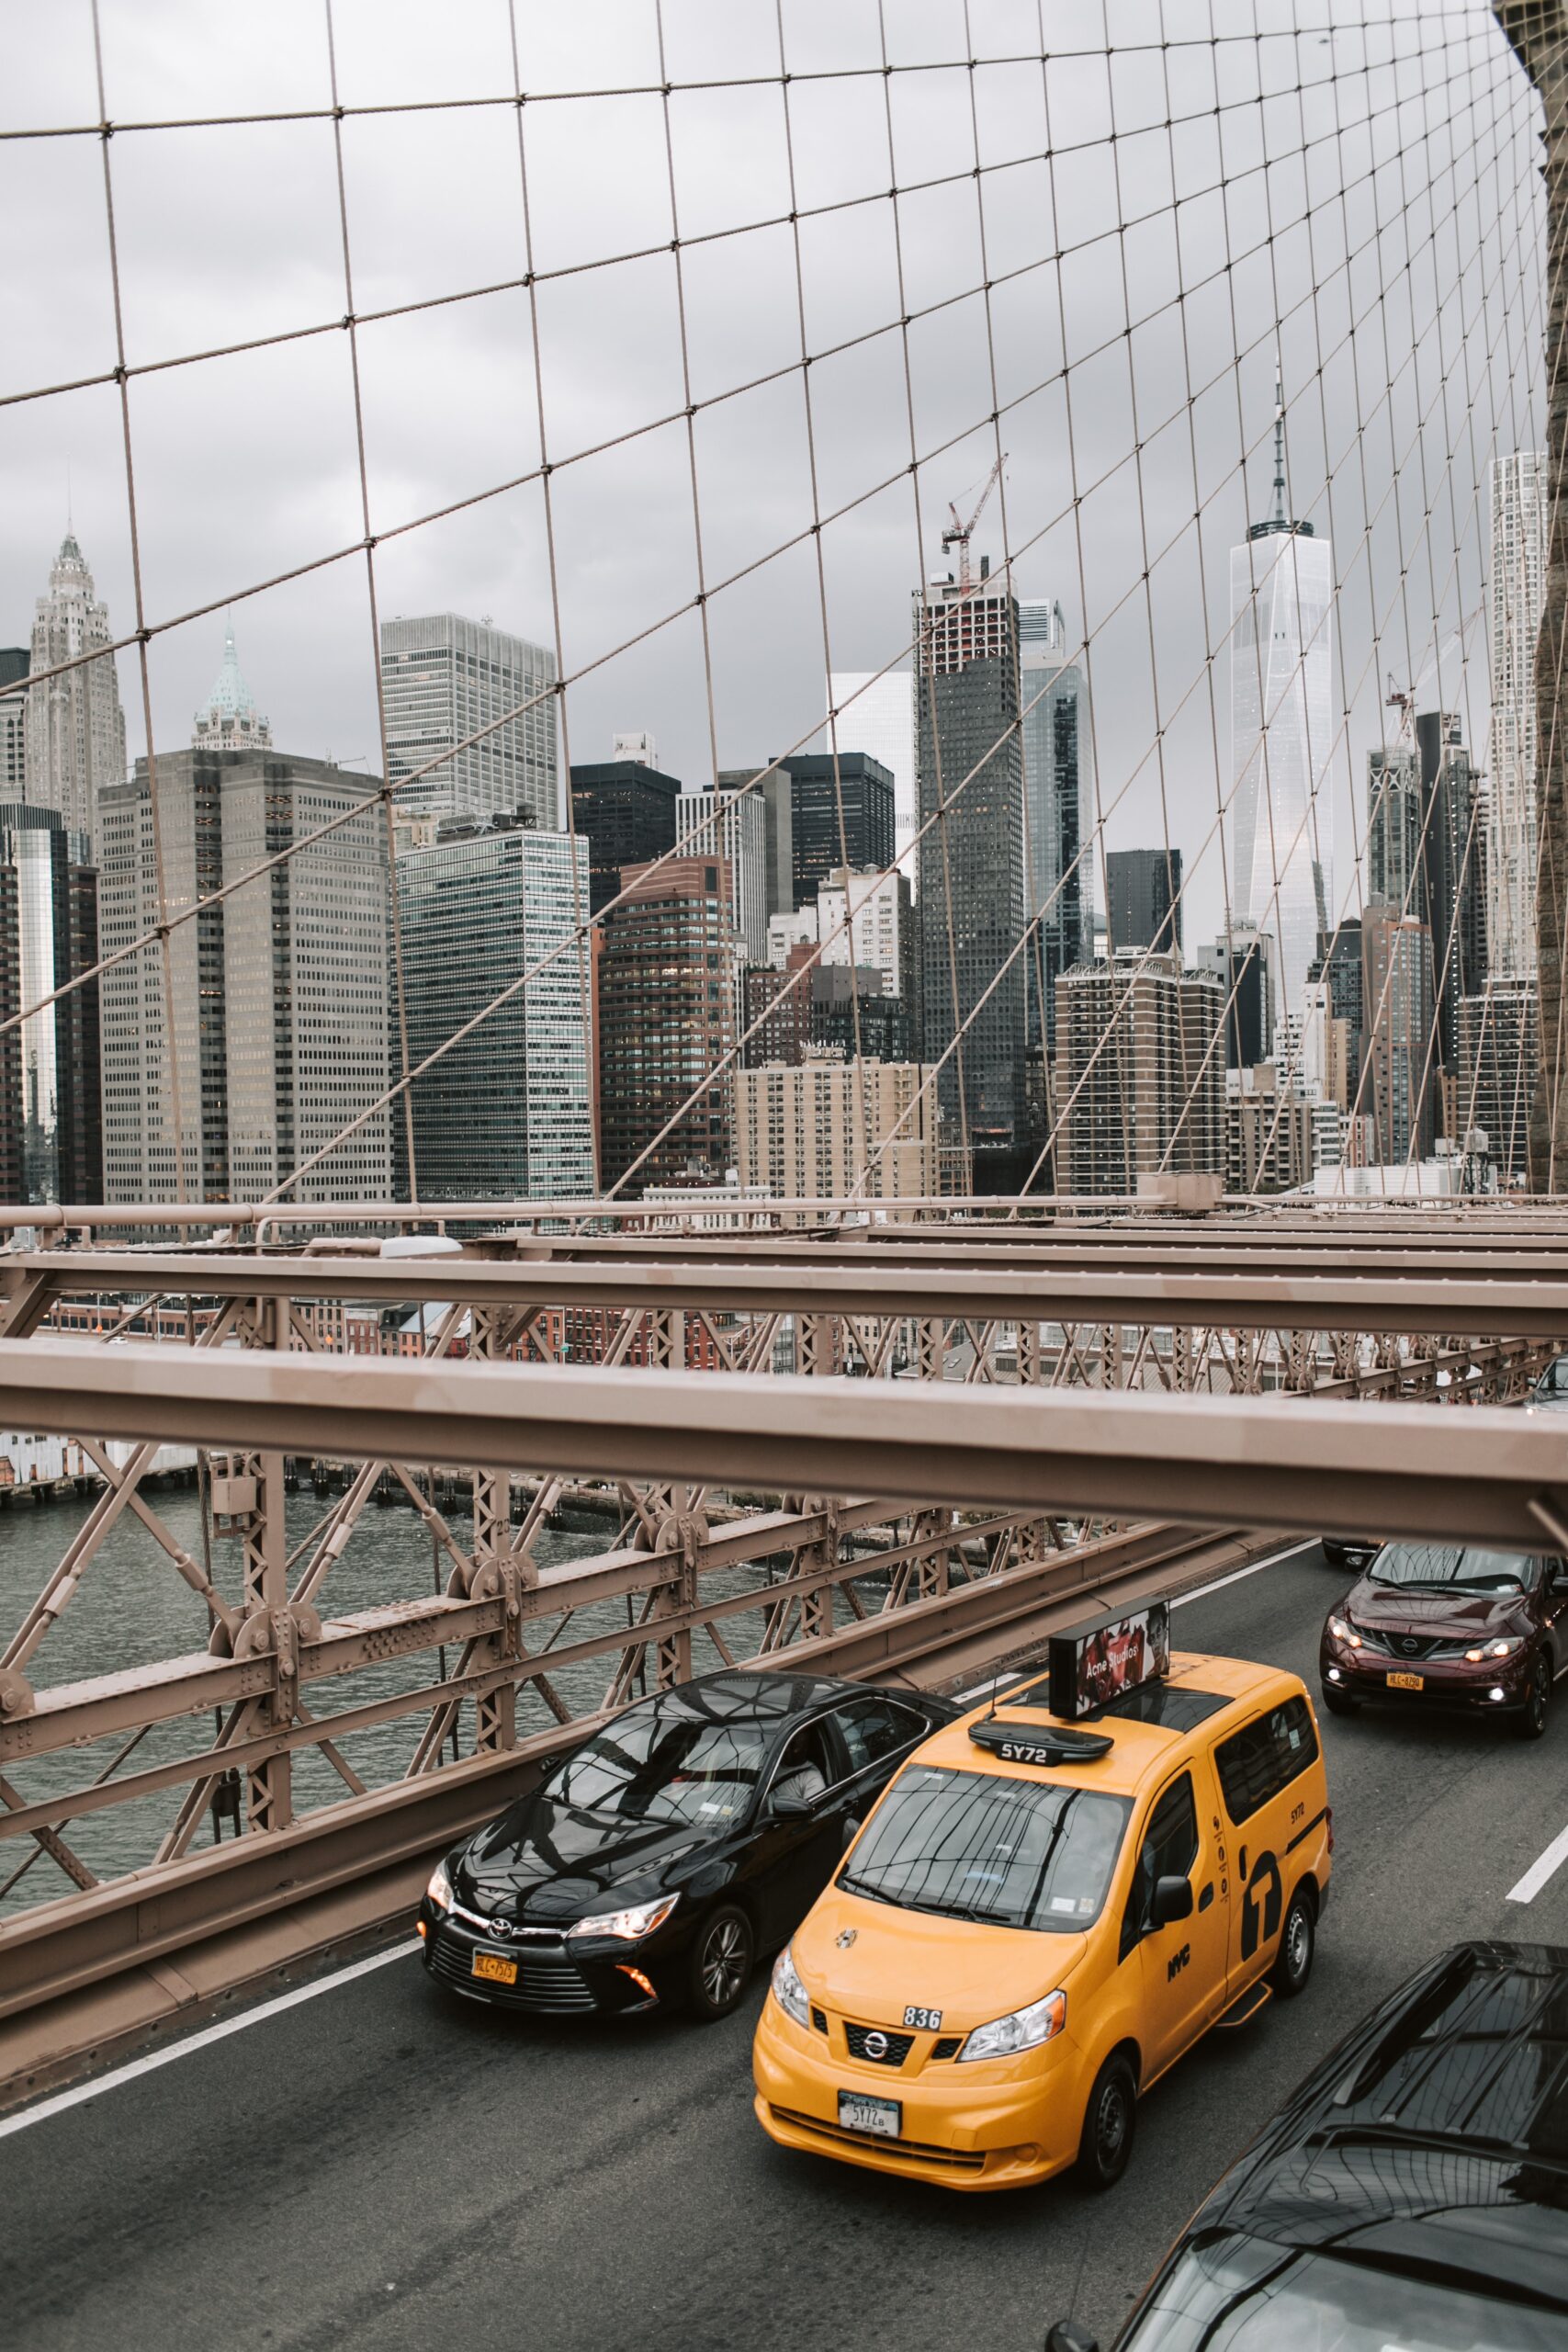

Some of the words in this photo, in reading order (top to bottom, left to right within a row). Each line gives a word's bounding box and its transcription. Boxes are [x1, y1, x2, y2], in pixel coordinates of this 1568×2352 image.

[1086, 1659, 1108, 1680] Acne
[1109, 1643, 1139, 1669] Studios
[1000, 1743, 1047, 1764] 5Y72
[1291, 1801, 1304, 1825] 5Y72
[1167, 1942, 1190, 1984] NYC
[904, 2007, 941, 2030] 836
